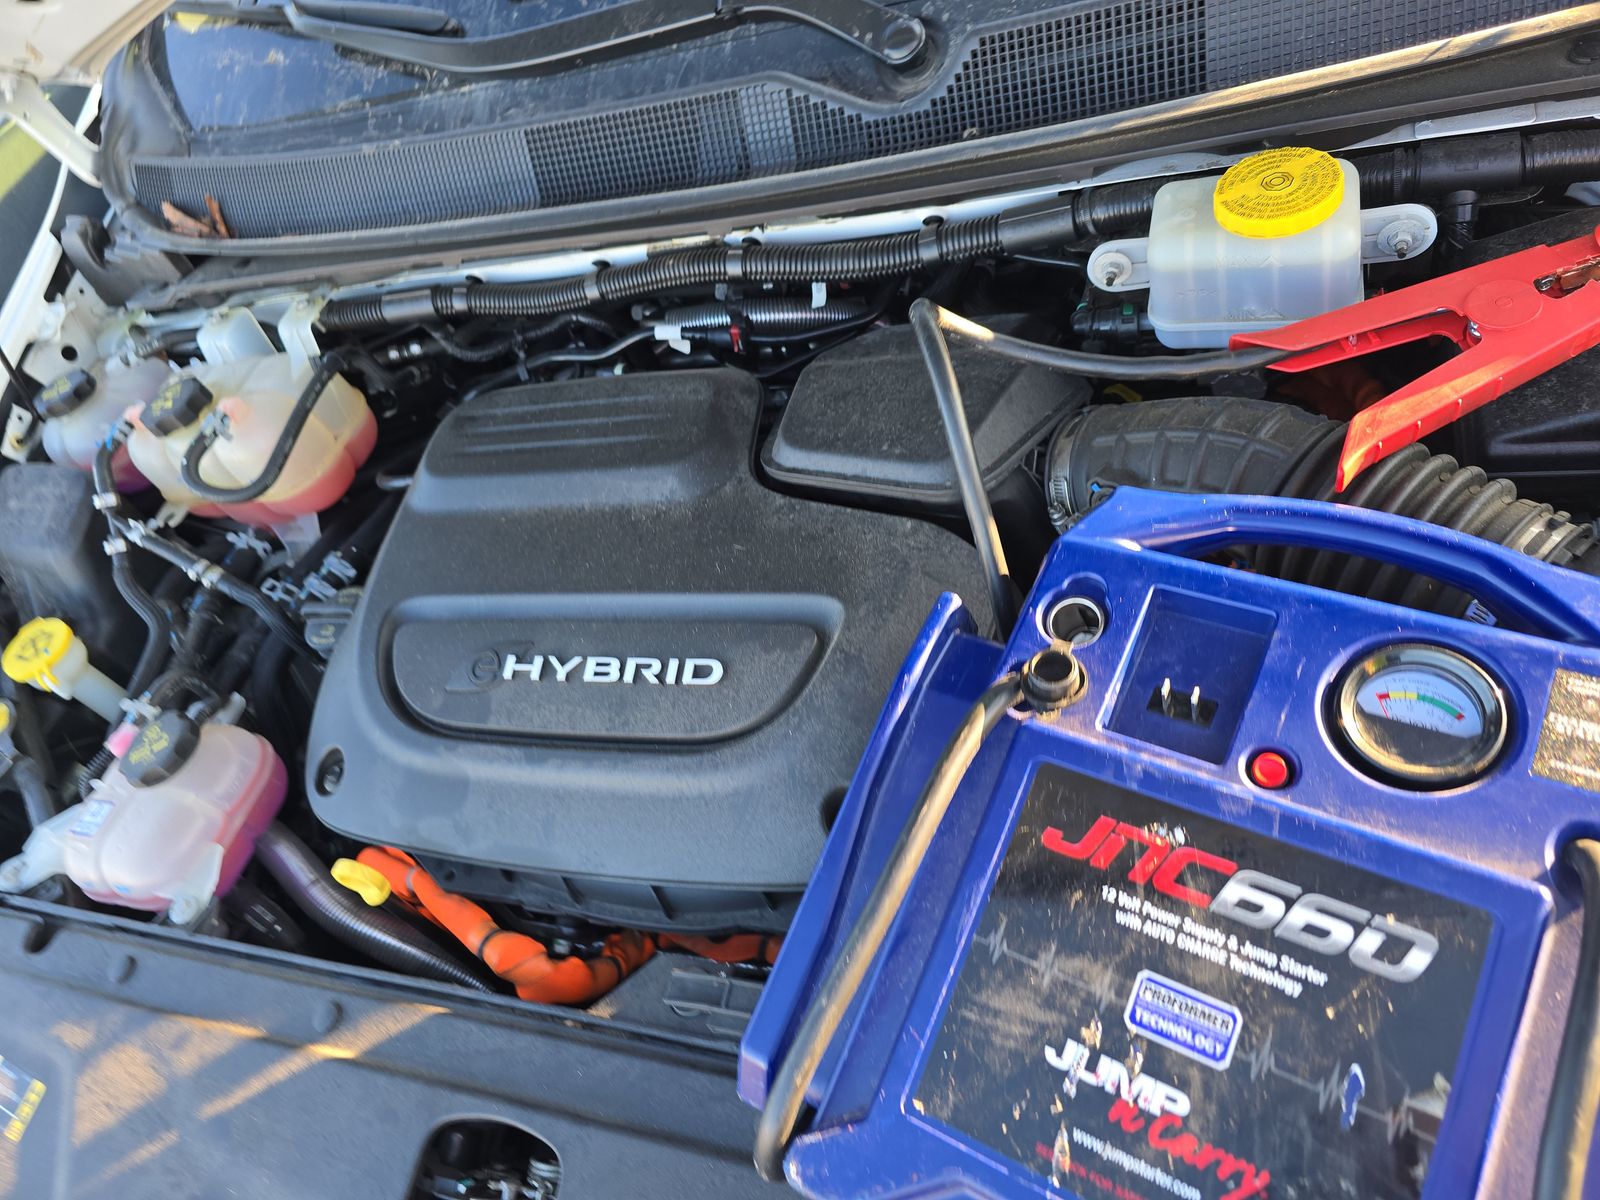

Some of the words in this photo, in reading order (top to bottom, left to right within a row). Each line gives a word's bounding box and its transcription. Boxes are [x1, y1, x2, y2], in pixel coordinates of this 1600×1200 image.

[1102, 885, 1117, 904] 12
[1118, 889, 1142, 911] Volt
[1142, 900, 1182, 928] Power
[1183, 916, 1226, 946] Supply
[1227, 934, 1239, 951] &
[1240, 940, 1278, 968] Jump
[1279, 954, 1329, 987] Starter
[1115, 909, 1142, 932] with
[1143, 920, 1176, 945] AUTO
[1229, 953, 1303, 999] Technology
[1135, 1005, 1226, 1058] TECHNOLOGY
[1044, 1038, 1190, 1117] JUMP
[1148, 1113, 1271, 1200] Carry
